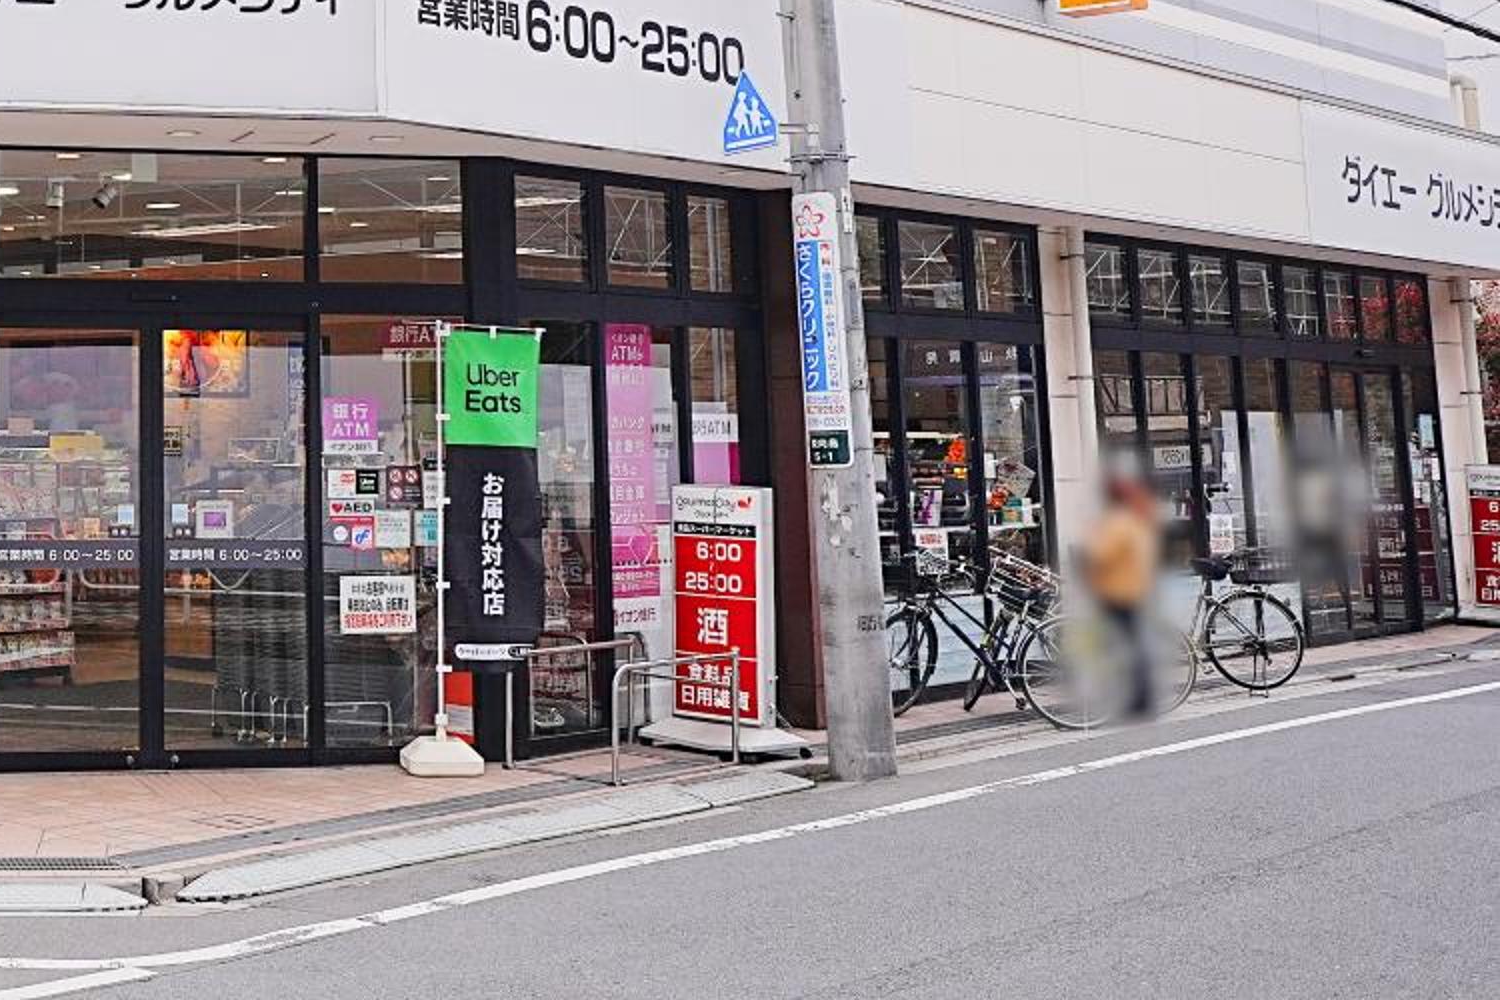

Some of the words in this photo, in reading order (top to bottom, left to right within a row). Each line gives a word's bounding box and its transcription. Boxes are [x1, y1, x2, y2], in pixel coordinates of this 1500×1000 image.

[1341, 154, 1417, 210] ダイエー
[800, 243, 820, 390] さくらクリニック
[466, 363, 520, 387] Uber
[331, 403, 369, 420] 銀行
[465, 388, 521, 414] Eats
[331, 422, 370, 437] ATM
[343, 502, 373, 513] AED
[481, 472, 505, 616] お届け対応店
[696, 541, 742, 561] 6:00
[685, 572, 742, 593] 25:00
[697, 607, 729, 646] 酒
